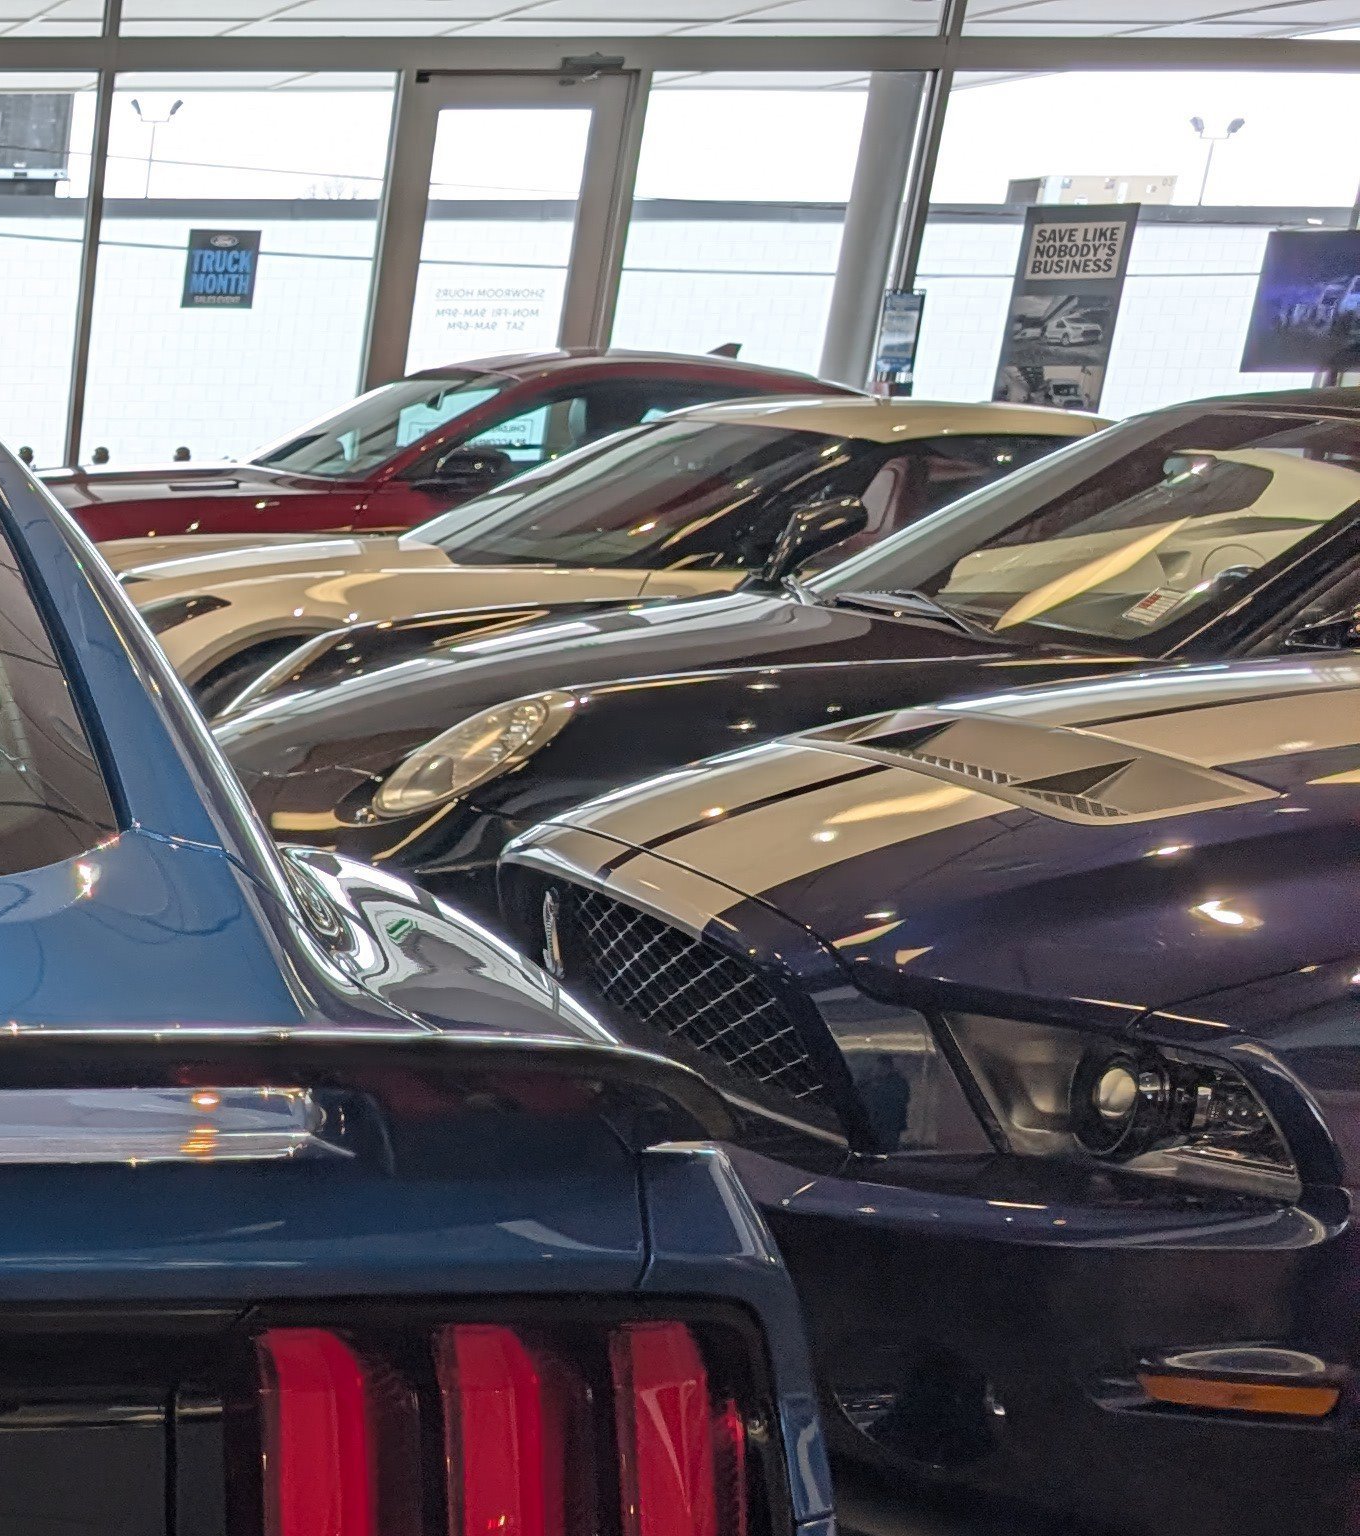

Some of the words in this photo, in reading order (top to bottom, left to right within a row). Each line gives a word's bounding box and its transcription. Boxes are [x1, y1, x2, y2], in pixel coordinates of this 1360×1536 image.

[1037, 228, 1078, 243] SAVE
[1082, 227, 1120, 242] LIKE
[1034, 243, 1117, 259] NOBODY'S
[192, 250, 252, 273] TRUCK
[1031, 258, 1113, 274] BUSINESS
[190, 273, 249, 294] MONTH
